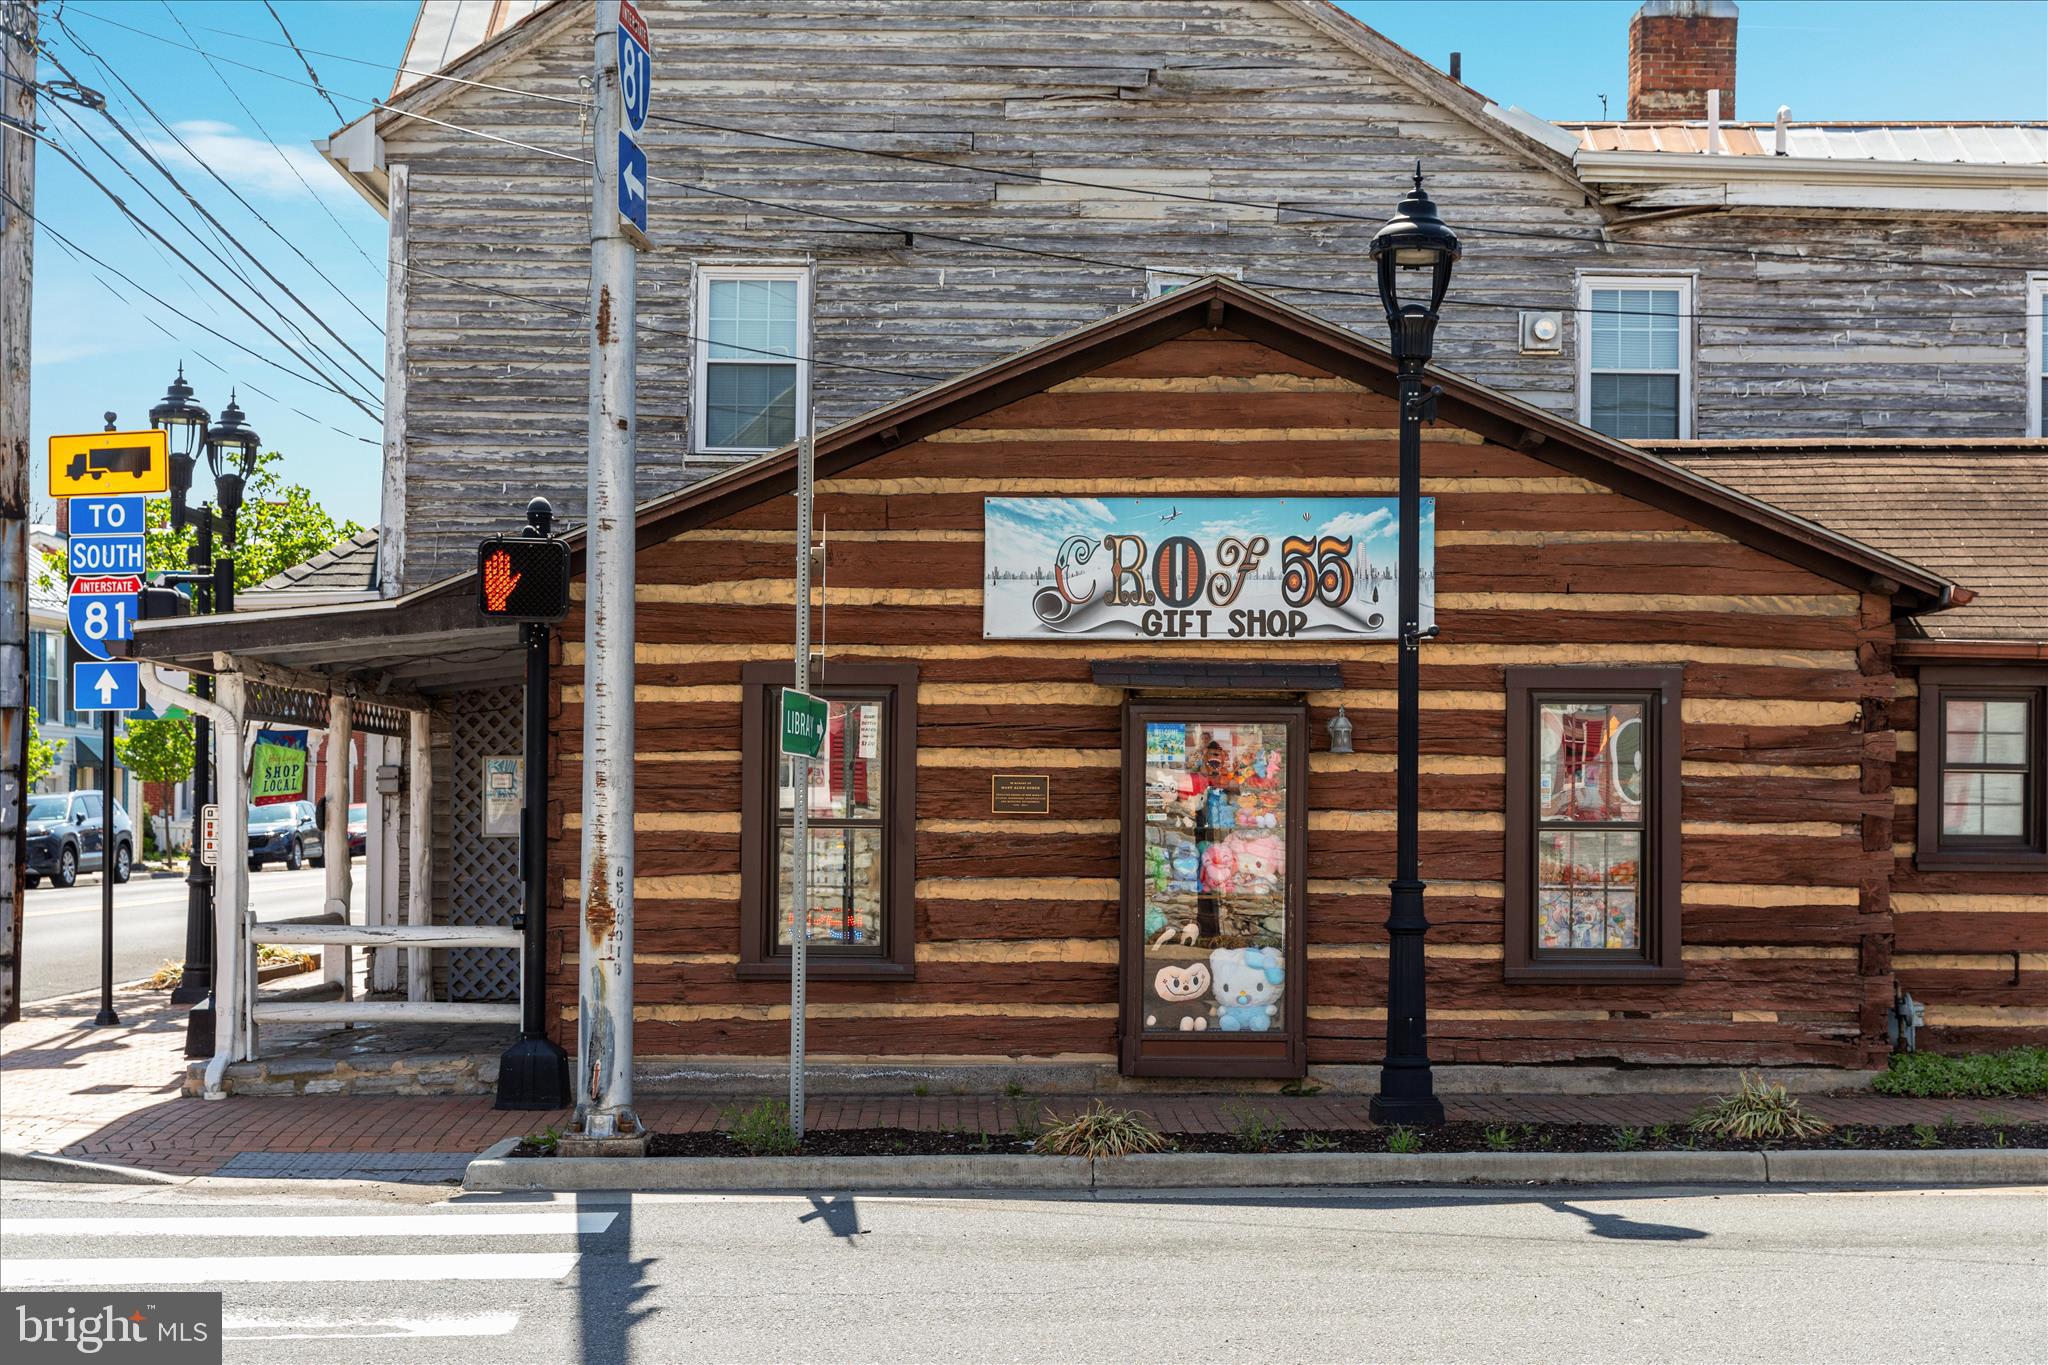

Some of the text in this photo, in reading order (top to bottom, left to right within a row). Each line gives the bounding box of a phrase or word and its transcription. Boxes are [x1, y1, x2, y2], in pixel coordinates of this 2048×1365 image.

[624, 38, 644, 120] 81
[88, 503, 126, 528] TO
[72, 543, 142, 569] SOUTH
[1055, 535, 1354, 609] CROF 55
[80, 580, 133, 593] INTERSTATE
[84, 601, 126, 640] 81
[1142, 608, 1308, 638] GIFT SHOP
[265, 764, 300, 779] SHOP
[262, 778, 298, 793] LOCAL
